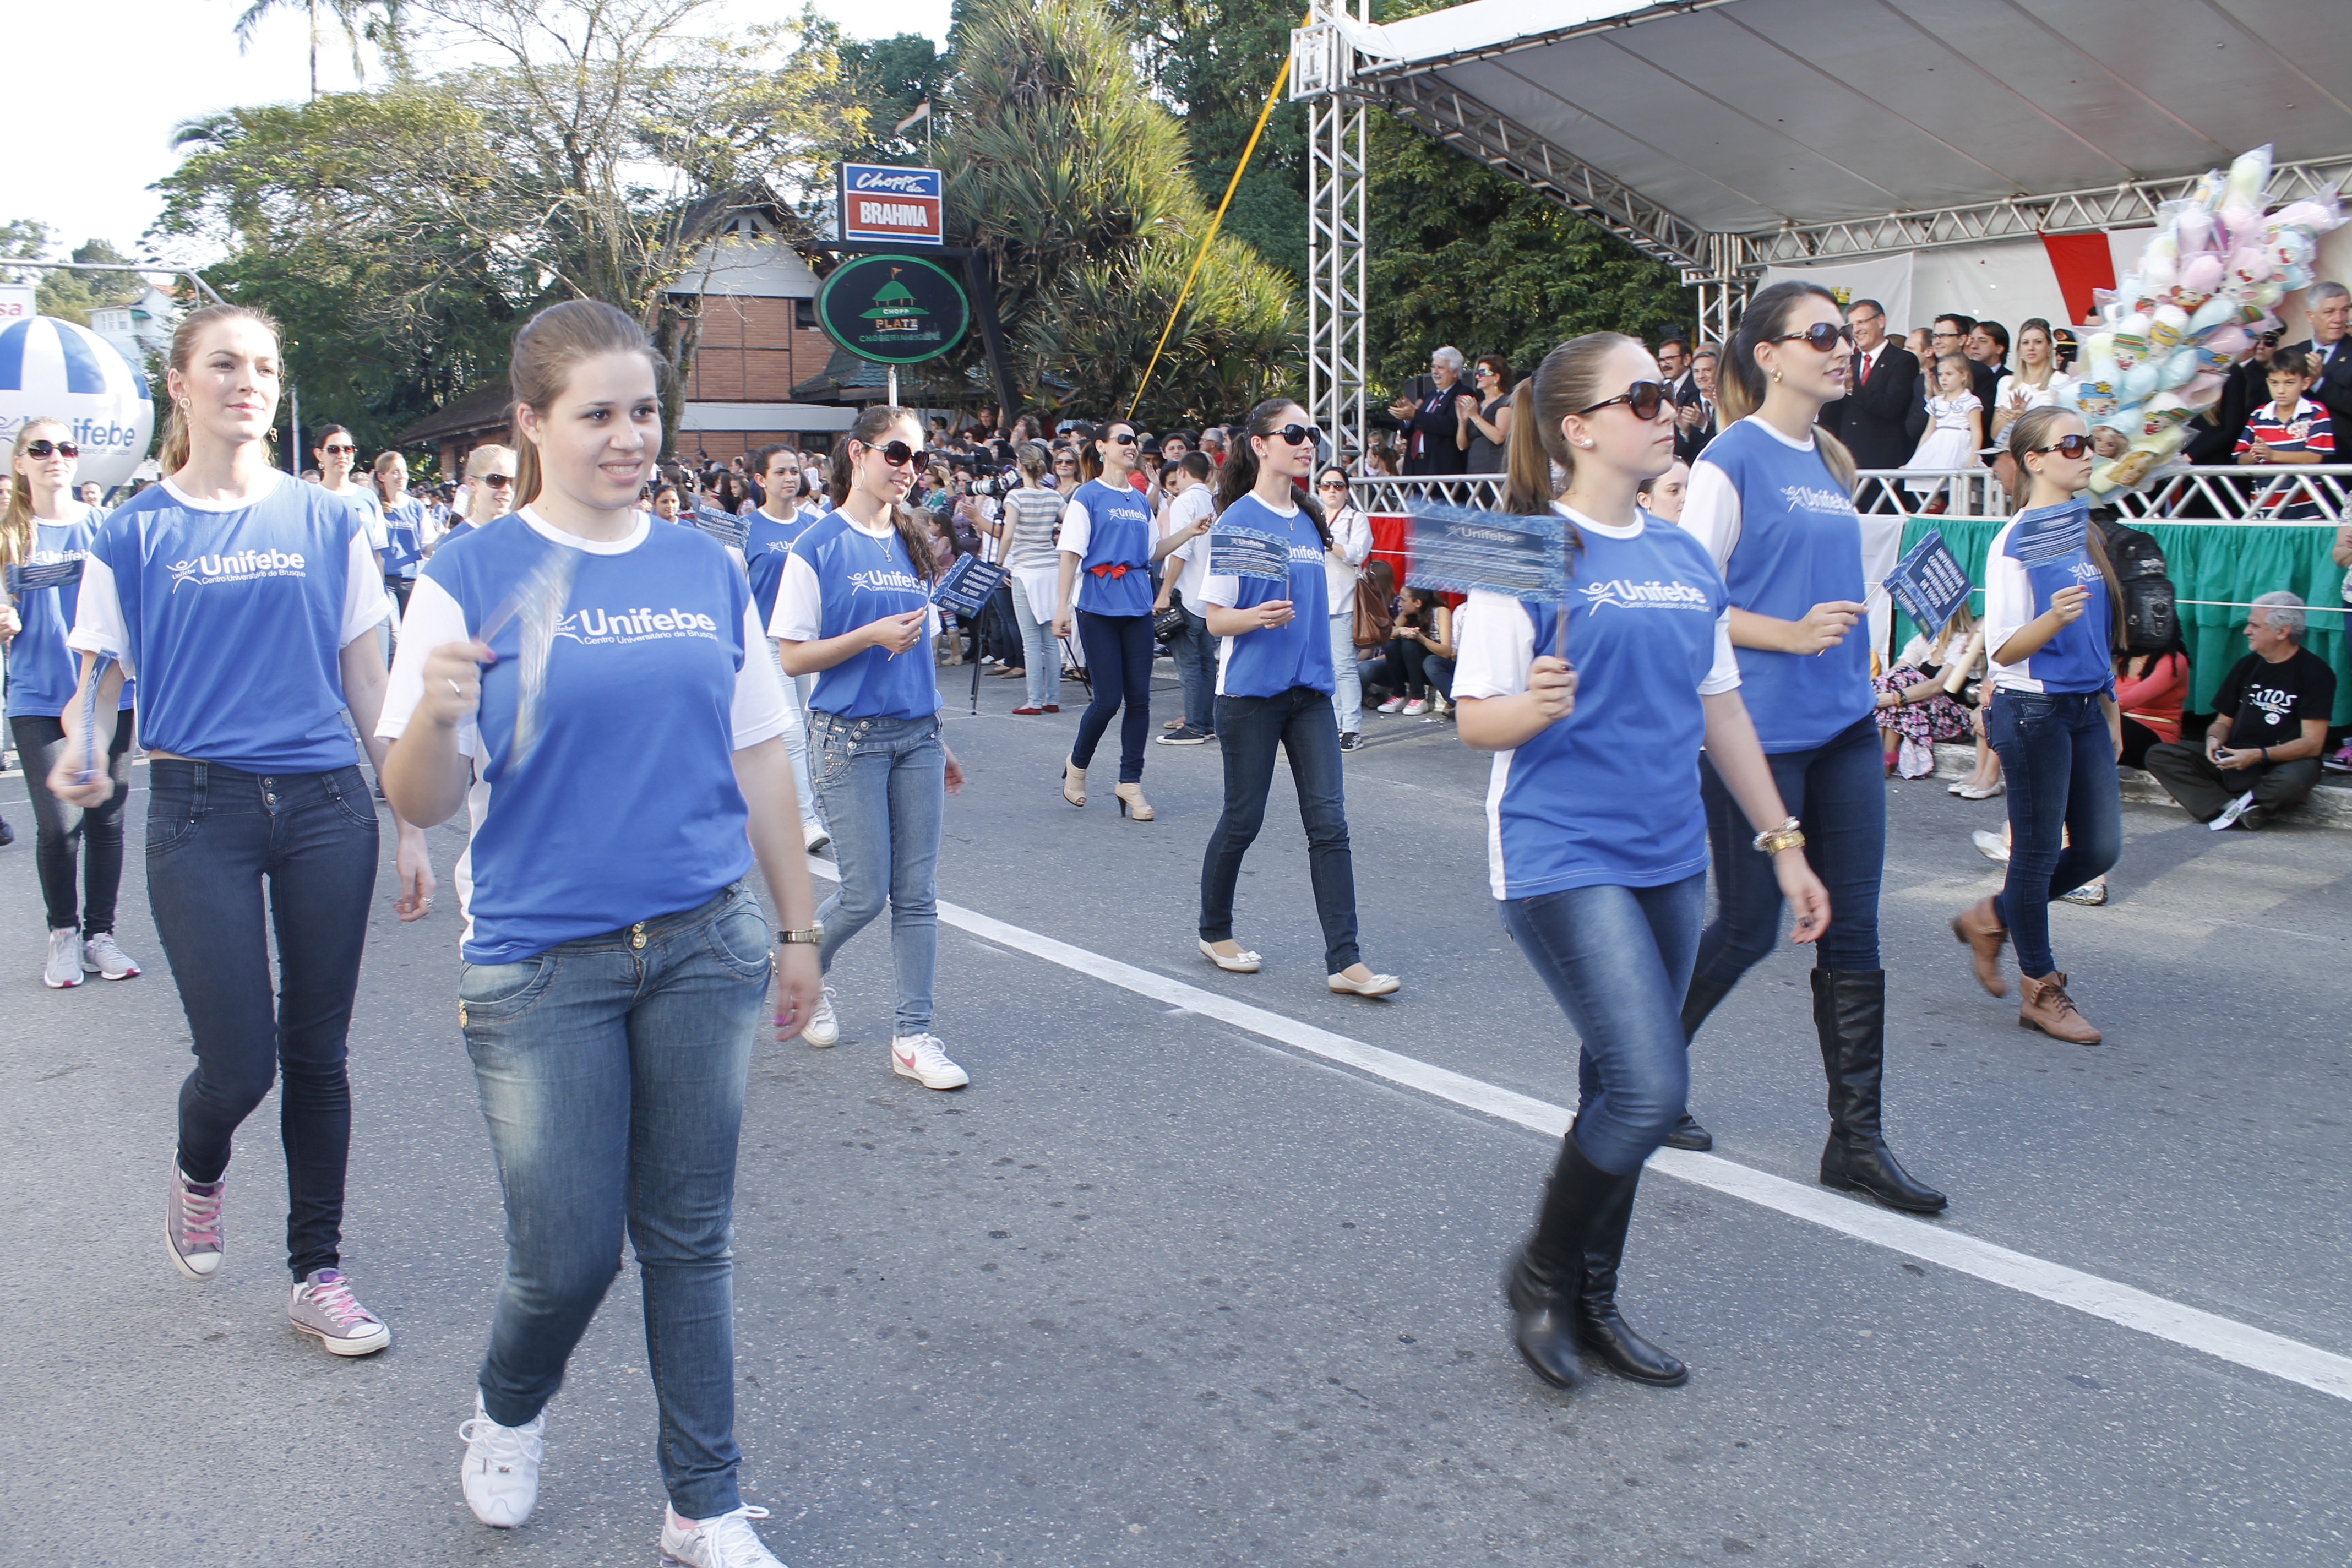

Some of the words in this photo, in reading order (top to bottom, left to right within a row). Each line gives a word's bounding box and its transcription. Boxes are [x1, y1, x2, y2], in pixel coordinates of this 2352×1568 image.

[856, 171, 932, 191] Chopp
[905, 182, 927, 193] da
[859, 201, 929, 227] BRAHMA
[875, 319, 919, 329] PLATZ
[42, 549, 90, 564] Unifeb
[200, 548, 306, 575] Unifebe
[172, 569, 197, 580] Unifebe
[202, 576, 226, 585] Centro
[279, 569, 306, 578] Brusque
[1611, 579, 1707, 604] Unifebe
[1919, 578, 1930, 591] DE
[579, 607, 717, 636] Unifebe
[584, 636, 615, 645] Centro
[616, 631, 672, 644] Universitário
[687, 630, 719, 642] Brusq
